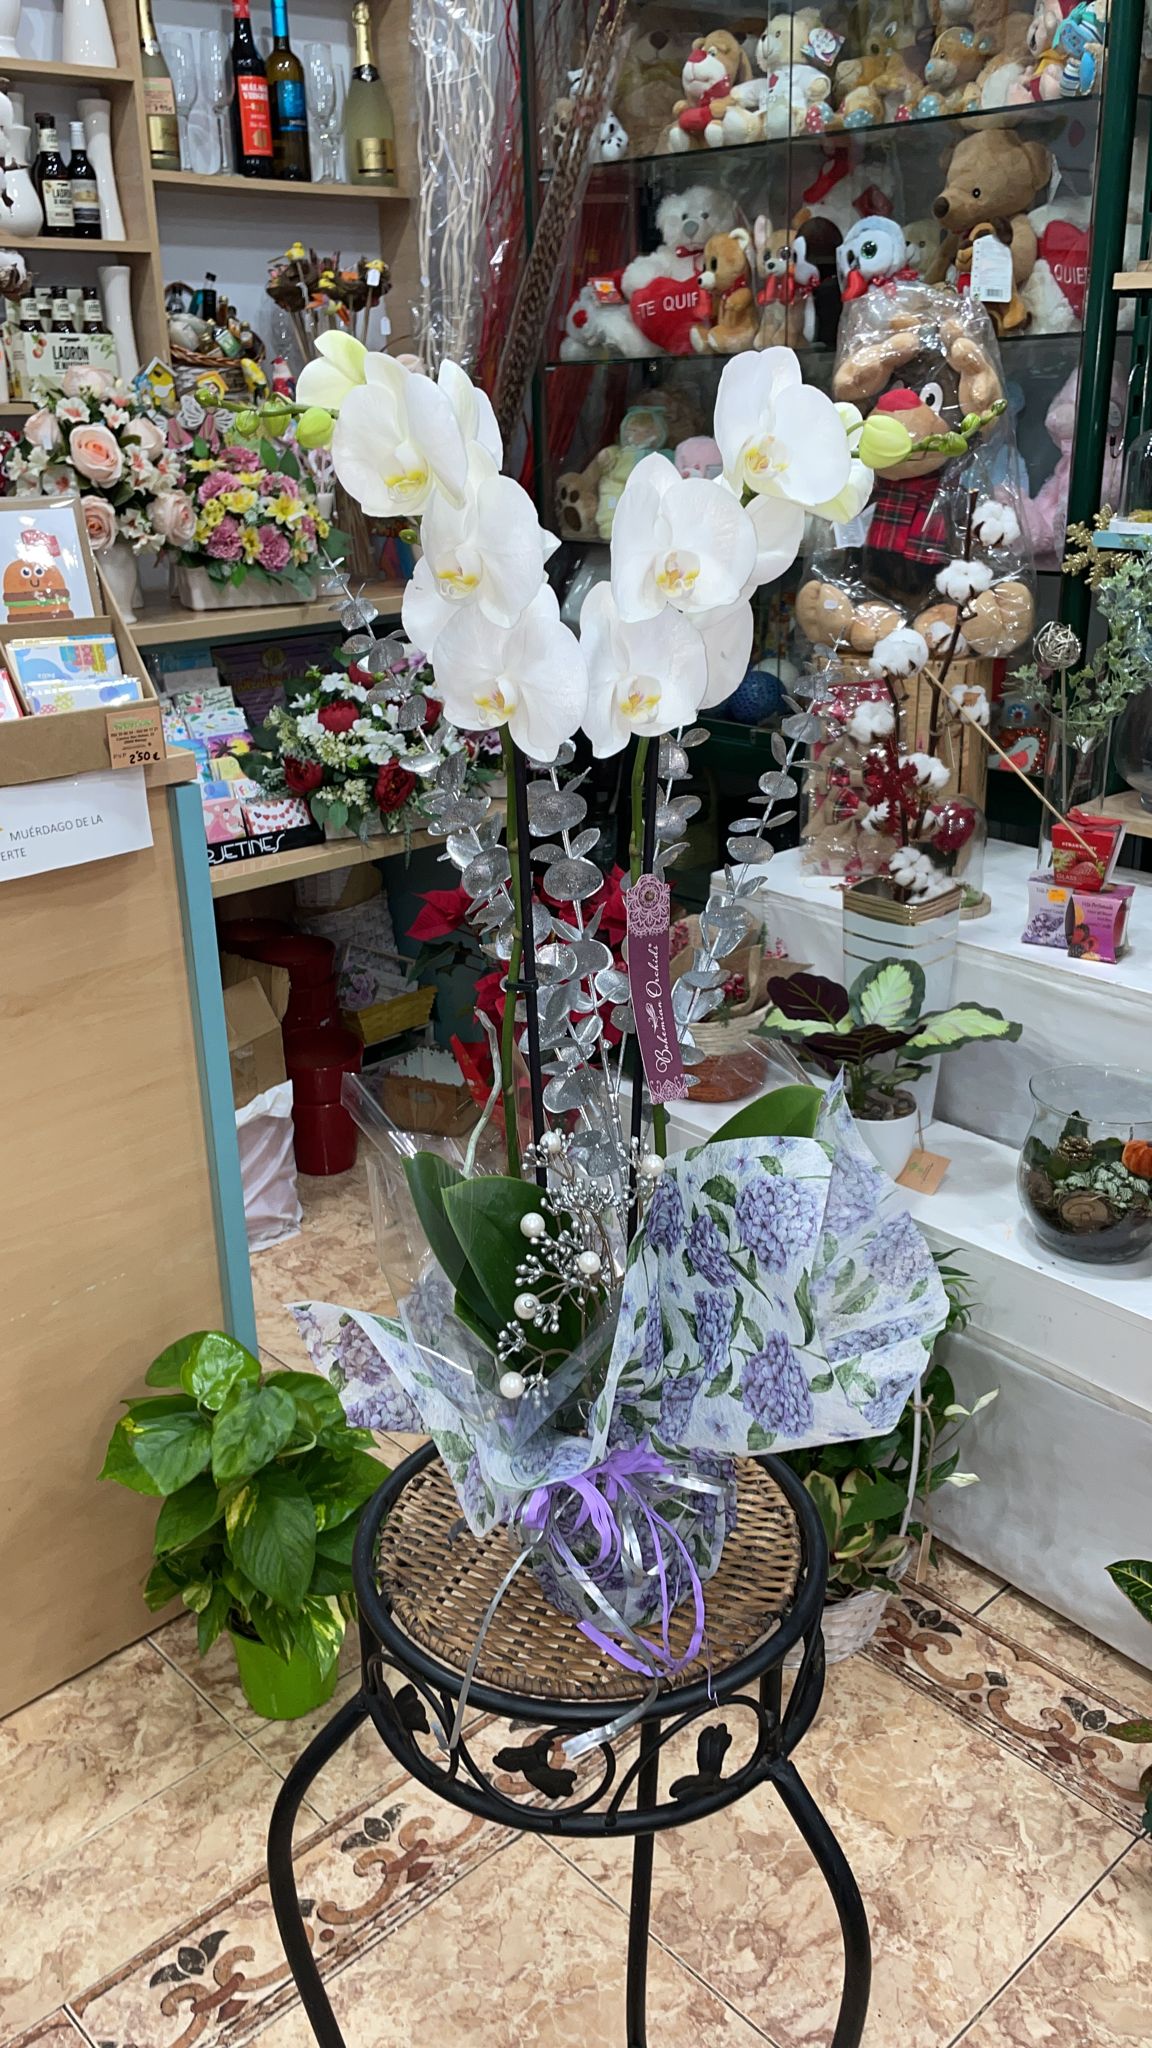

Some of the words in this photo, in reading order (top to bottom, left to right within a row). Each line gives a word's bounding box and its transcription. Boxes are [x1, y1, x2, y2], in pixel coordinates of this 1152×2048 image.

[636, 300, 656, 319] TE
[9, 820, 74, 841] MUÉRDAGO
[75, 817, 89, 828] DE
[91, 814, 104, 825] LA
[654, 1000, 674, 1073] Bohemian
